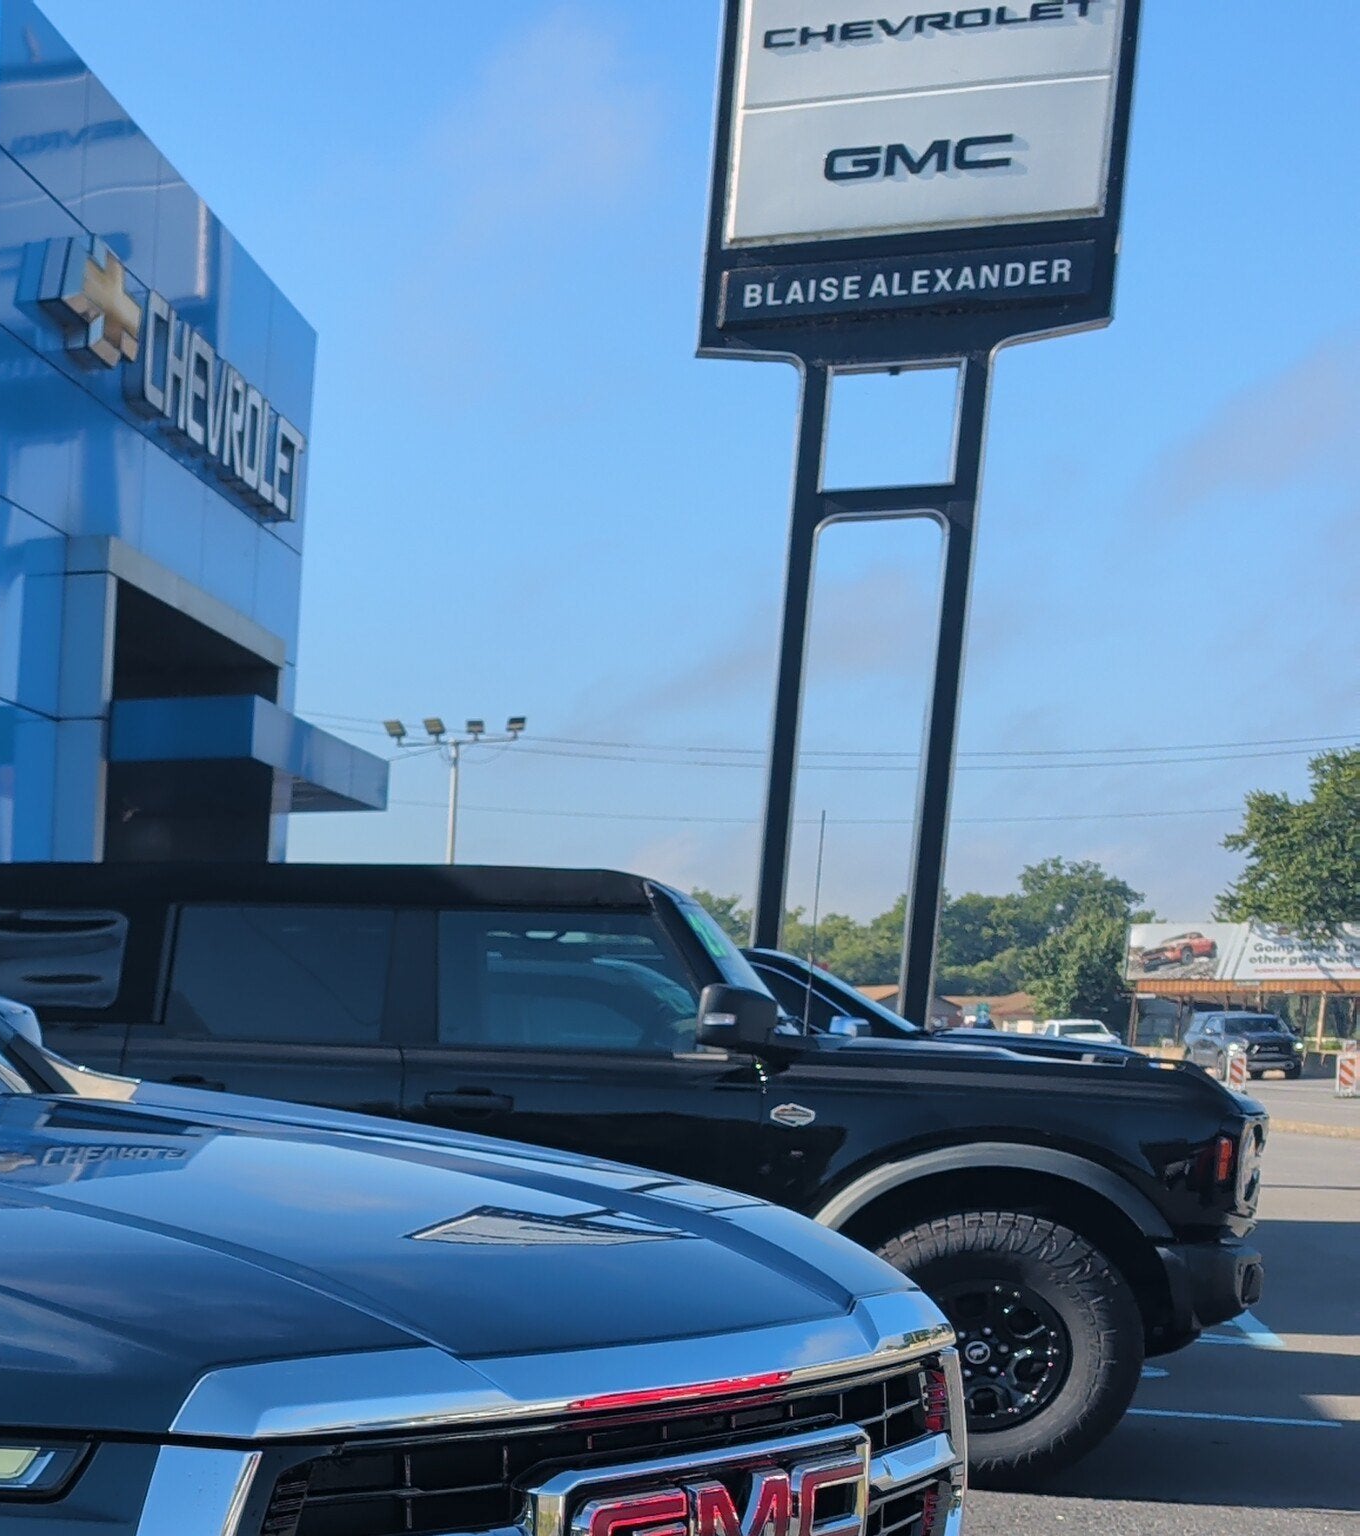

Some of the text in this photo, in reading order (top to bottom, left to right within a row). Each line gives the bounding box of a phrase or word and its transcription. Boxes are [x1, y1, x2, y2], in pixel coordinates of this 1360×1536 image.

[763, 0, 1099, 49] CHEVROLET
[823, 133, 1014, 182] GMC
[742, 258, 1074, 310] BLAISE ALEXANDER
[143, 289, 307, 522] CHEVROLET
[1249, 955, 1286, 965] other
